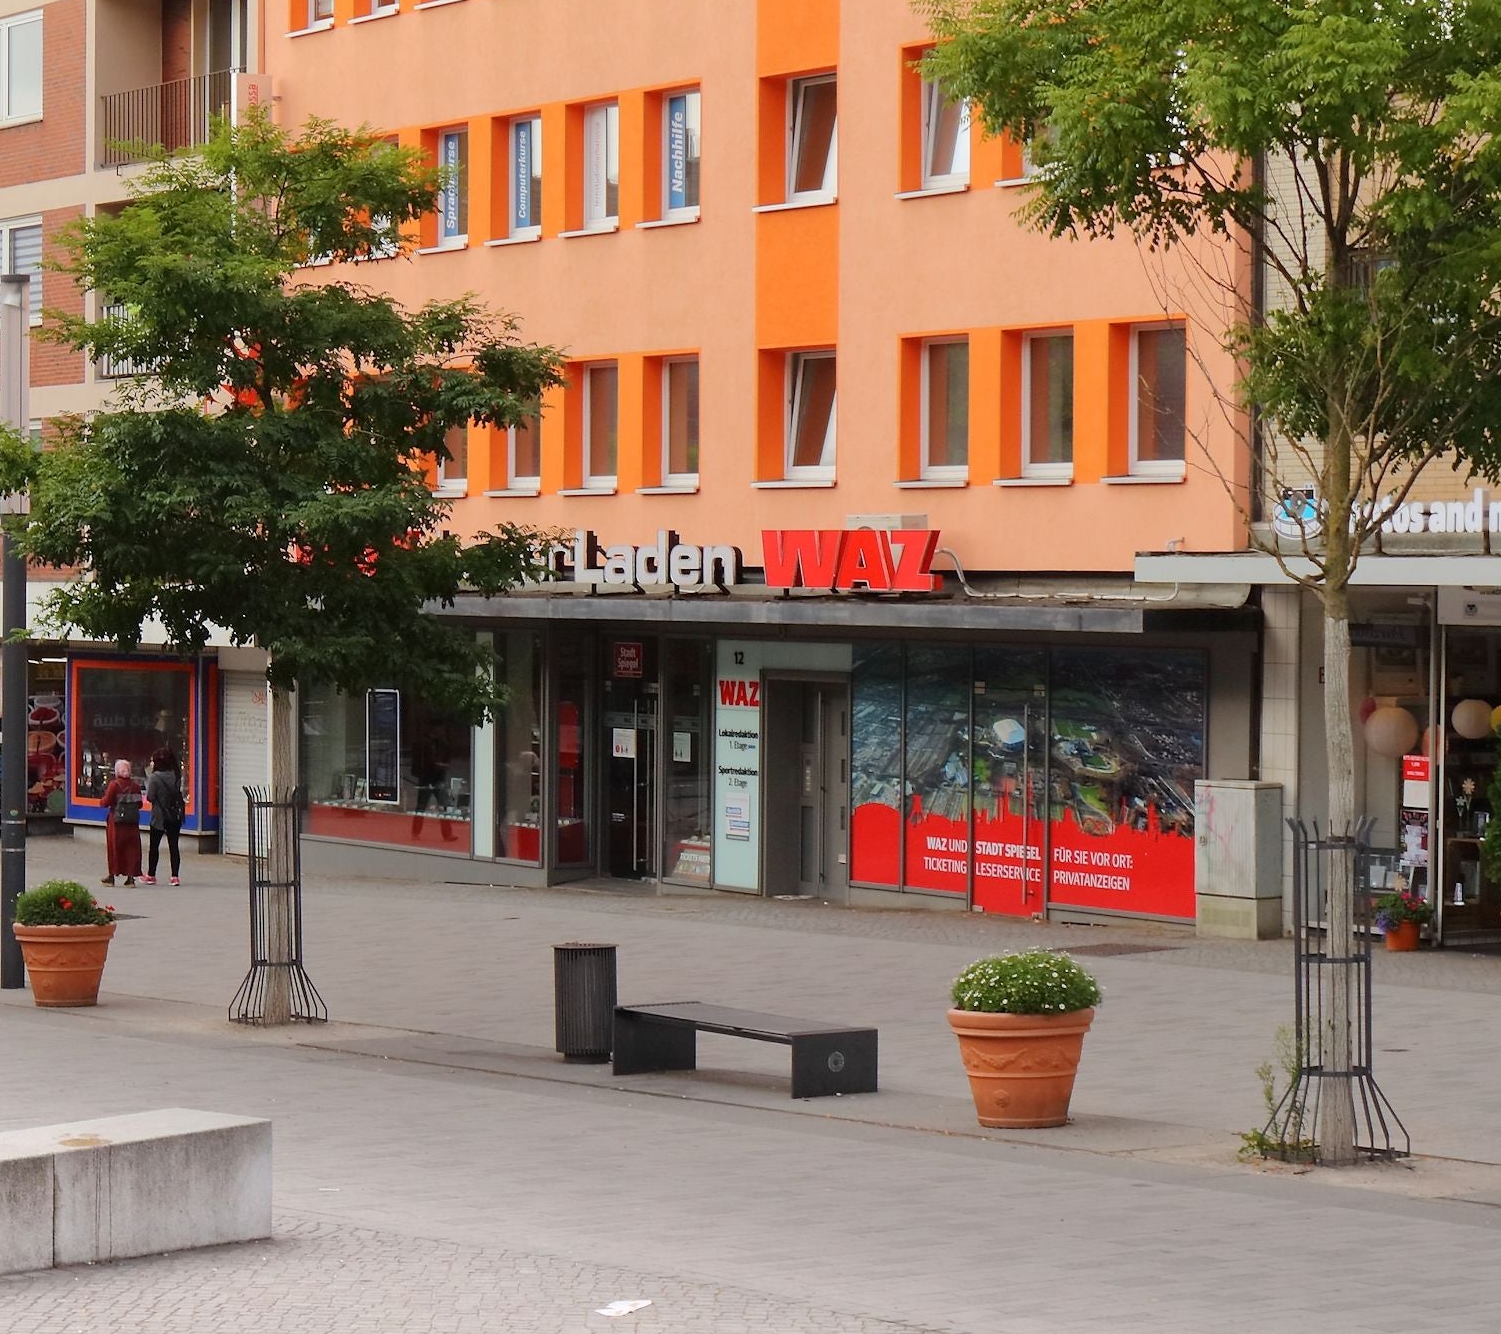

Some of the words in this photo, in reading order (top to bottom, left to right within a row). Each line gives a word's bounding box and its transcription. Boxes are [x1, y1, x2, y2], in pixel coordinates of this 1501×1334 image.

[1428, 488, 1483, 533] and
[761, 529, 942, 593] WAZ
[620, 646, 636, 658] Stadt
[734, 651, 745, 665] 12
[617, 658, 639, 671] Spiegel
[718, 680, 760, 707] WAZ
[719, 729, 759, 739] Lokalredaktion
[729, 741, 733, 749] 1.
[734, 741, 748, 751] Etage
[719, 765, 758, 777] Sportredaktion
[728, 778, 733, 786] 2.
[734, 778, 748, 788] Etage
[926, 836, 947, 851] WAZ
[949, 838, 968, 854] UND
[975, 841, 1003, 856] STADT
[1005, 843, 1041, 860] SPIEGEL
[1054, 846, 1072, 864] FÜR
[1074, 850, 1089, 865] SIE
[1090, 852, 1111, 867] VOR
[1112, 854, 1134, 869] ORT:
[923, 856, 967, 874] TICKETING
[975, 862, 1041, 883] LESERSERVICE
[1053, 870, 1130, 891] PRIVATANZEIGEN
